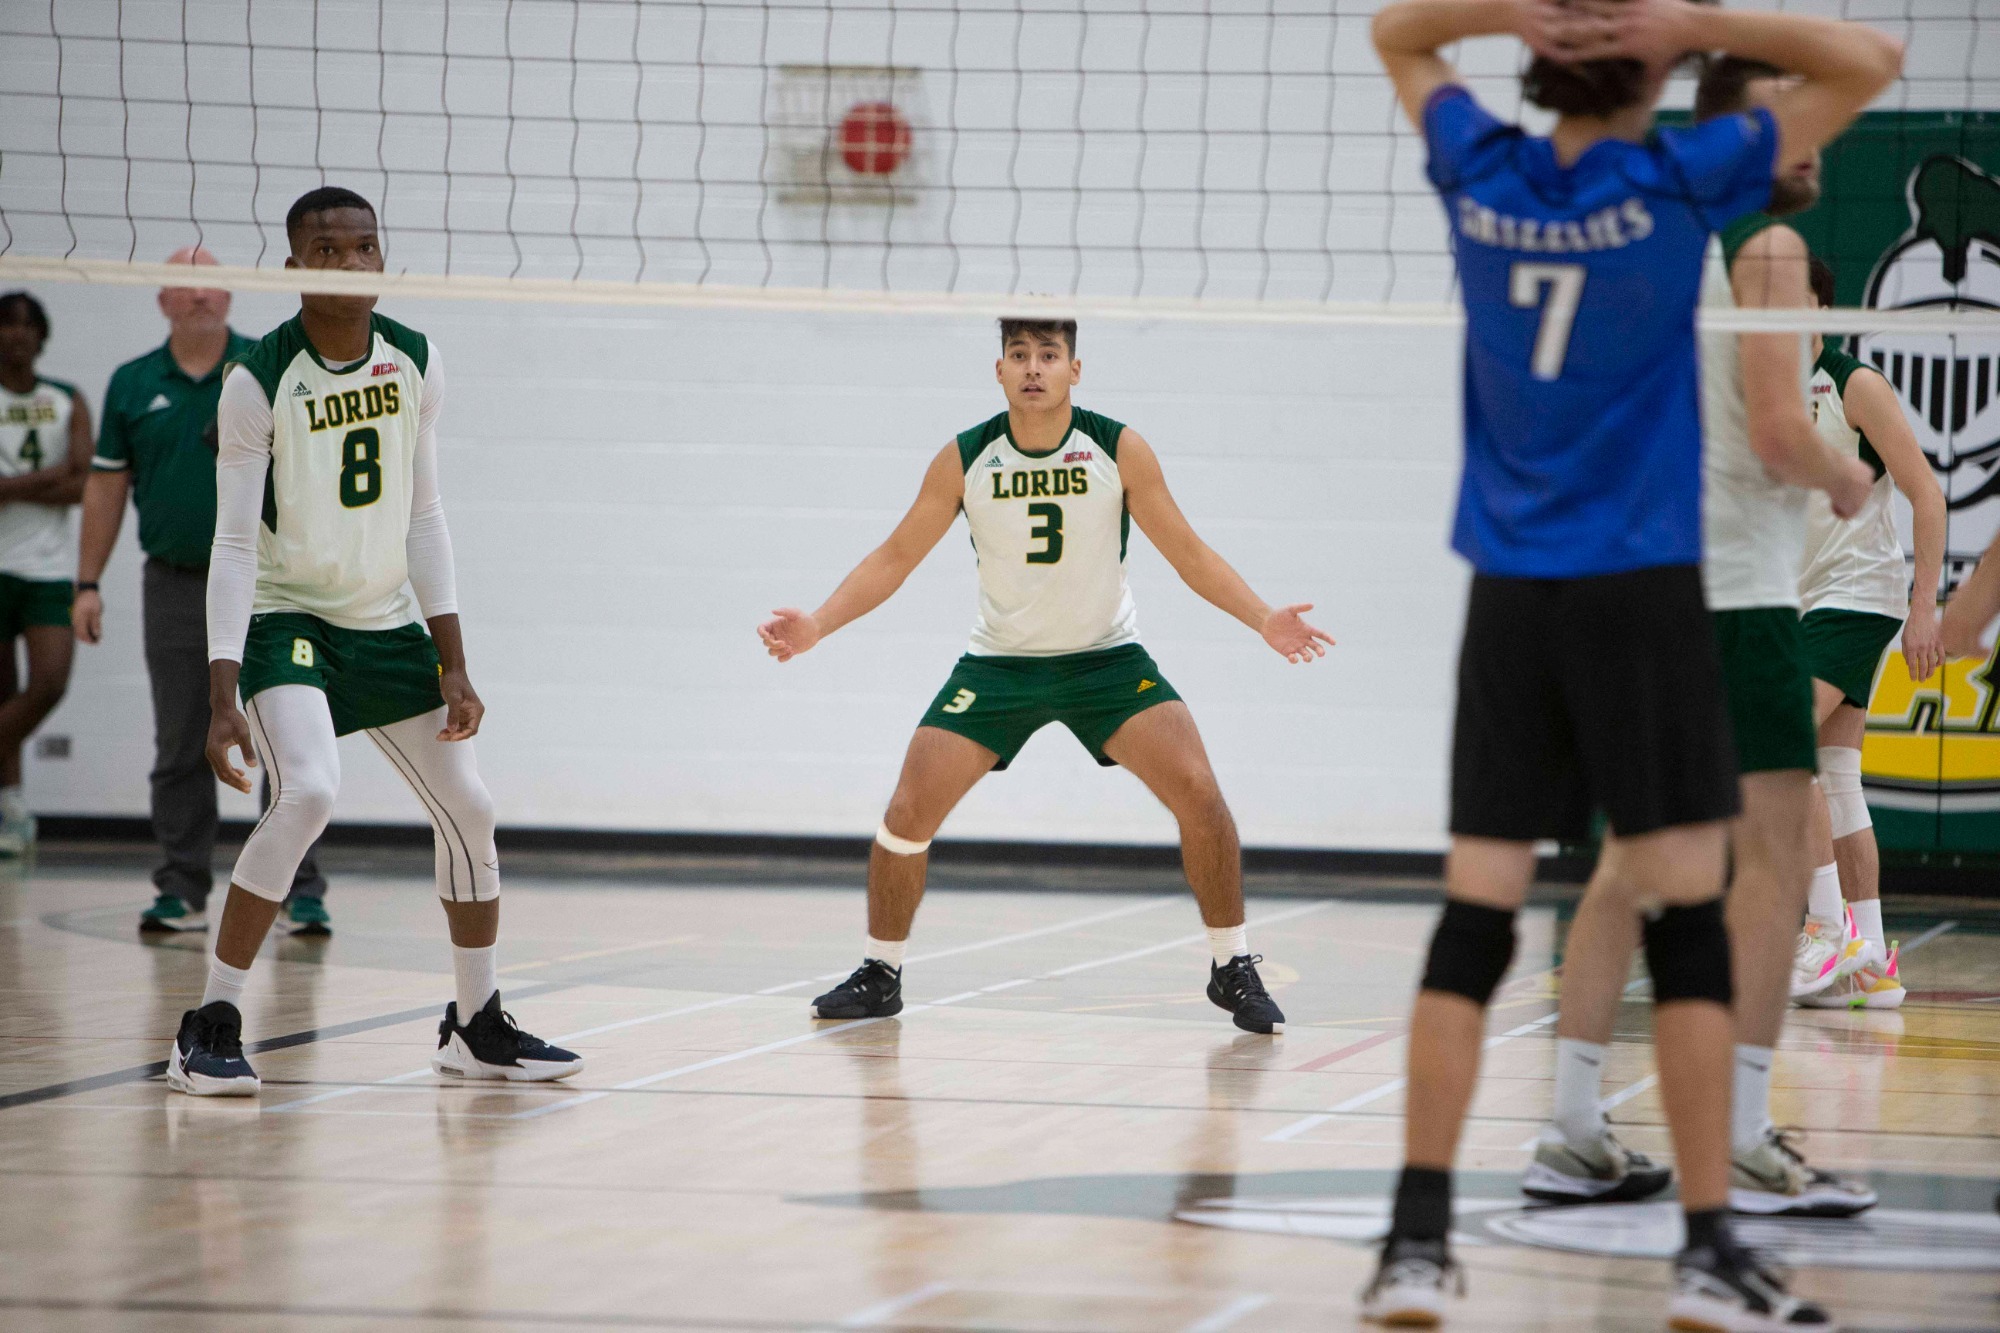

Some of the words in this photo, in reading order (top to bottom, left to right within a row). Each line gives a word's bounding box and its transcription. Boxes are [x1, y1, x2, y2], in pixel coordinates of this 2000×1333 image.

[1508, 261, 1588, 382] 7
[304, 381, 400, 433] LORDS
[18, 428, 44, 471] 4
[339, 426, 383, 509] 8
[992, 466, 1088, 500] LORDS
[1026, 502, 1065, 565] 3
[292, 637, 314, 667] 8
[942, 687, 977, 714] 3
